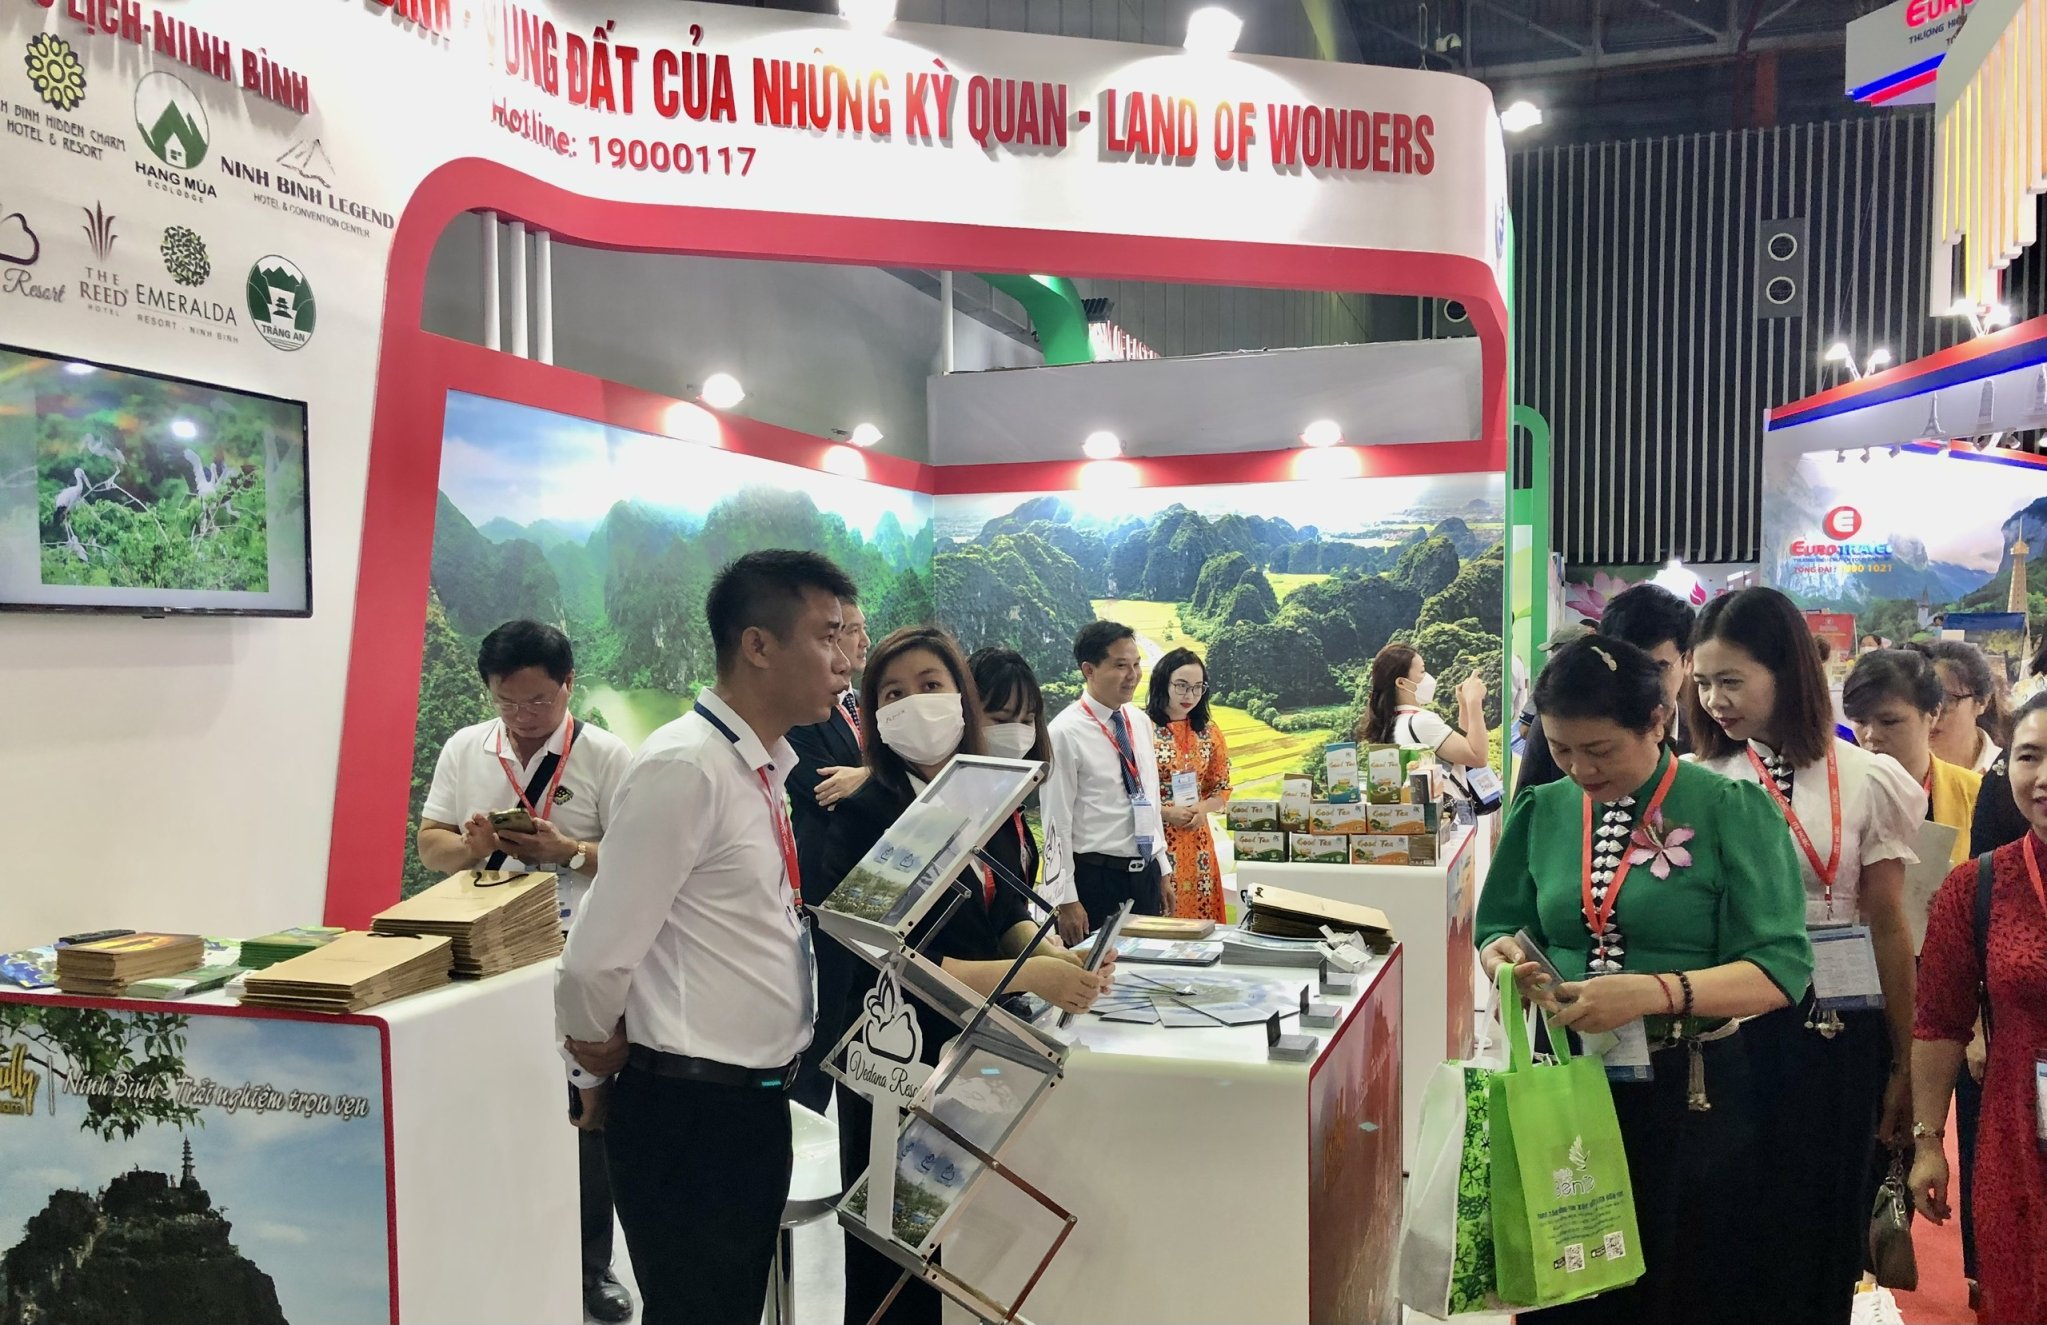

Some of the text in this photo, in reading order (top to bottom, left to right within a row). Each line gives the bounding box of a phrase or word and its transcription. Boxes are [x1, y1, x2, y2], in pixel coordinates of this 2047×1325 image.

[565, 20, 639, 113] ĐẤT
[653, 24, 737, 123] CỦA
[906, 57, 953, 138] KỲ
[968, 75, 1067, 147] QUAN
[1107, 88, 1198, 158] LAND
[1214, 101, 1255, 161] OF
[1268, 103, 1435, 176] WONDERS
[7, 119, 104, 161] HOTEL & RESORT
[45, 114, 85, 139] HIDDEN
[90, 129, 126, 152] CHARM
[135, 160, 181, 185] HANG
[588, 135, 757, 177] 19000117
[147, 179, 204, 204] ECOLODGE
[220, 155, 270, 188] NINH
[328, 194, 395, 230] LEGEND
[253, 192, 371, 239] HOTEL & CONVENTION CENTER
[3, 267, 66, 303] Resort
[80, 280, 128, 308] REED
[85, 266, 120, 286] THE
[88, 304, 120, 317] HOTEL
[136, 283, 238, 327] EMERALDA
[137, 313, 177, 330] RESORT
[293, 331, 305, 342] AN
[850, 1050, 887, 1088] Vedana
[216, 1081, 286, 1114] nghiệm
[288, 1089, 332, 1119] trọn
[335, 1095, 370, 1122] vẹn
